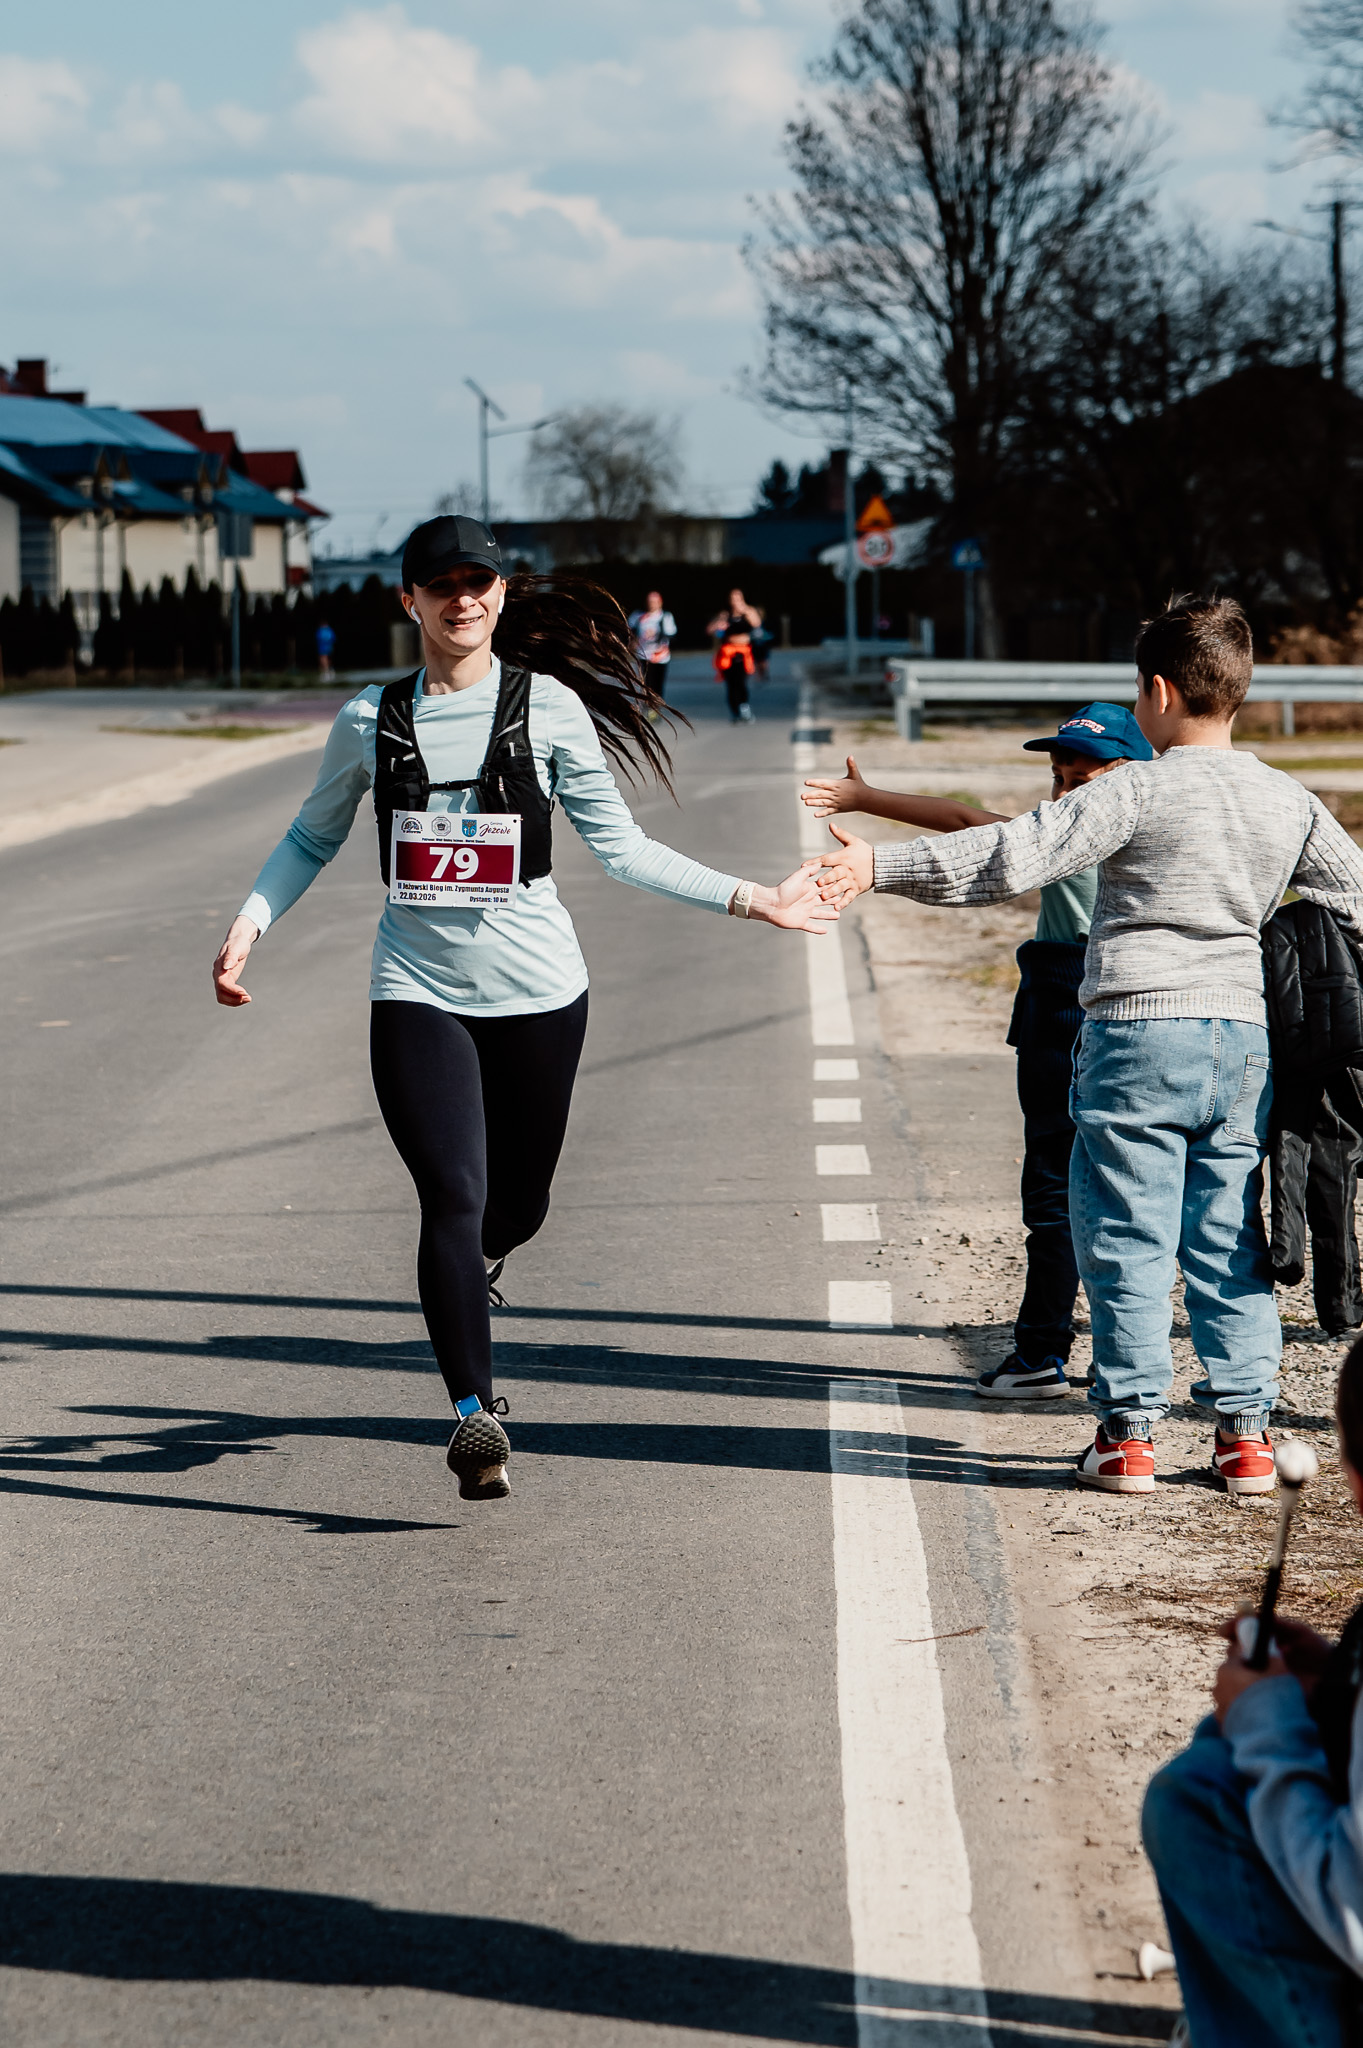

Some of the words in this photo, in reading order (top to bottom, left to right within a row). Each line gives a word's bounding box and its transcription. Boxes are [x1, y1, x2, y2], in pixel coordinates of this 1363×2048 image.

[429, 847, 479, 880] 79
[454, 885, 484, 893] Zygmunta
[485, 886, 510, 894] Augusta
[399, 891, 436, 900] 22.03.2026
